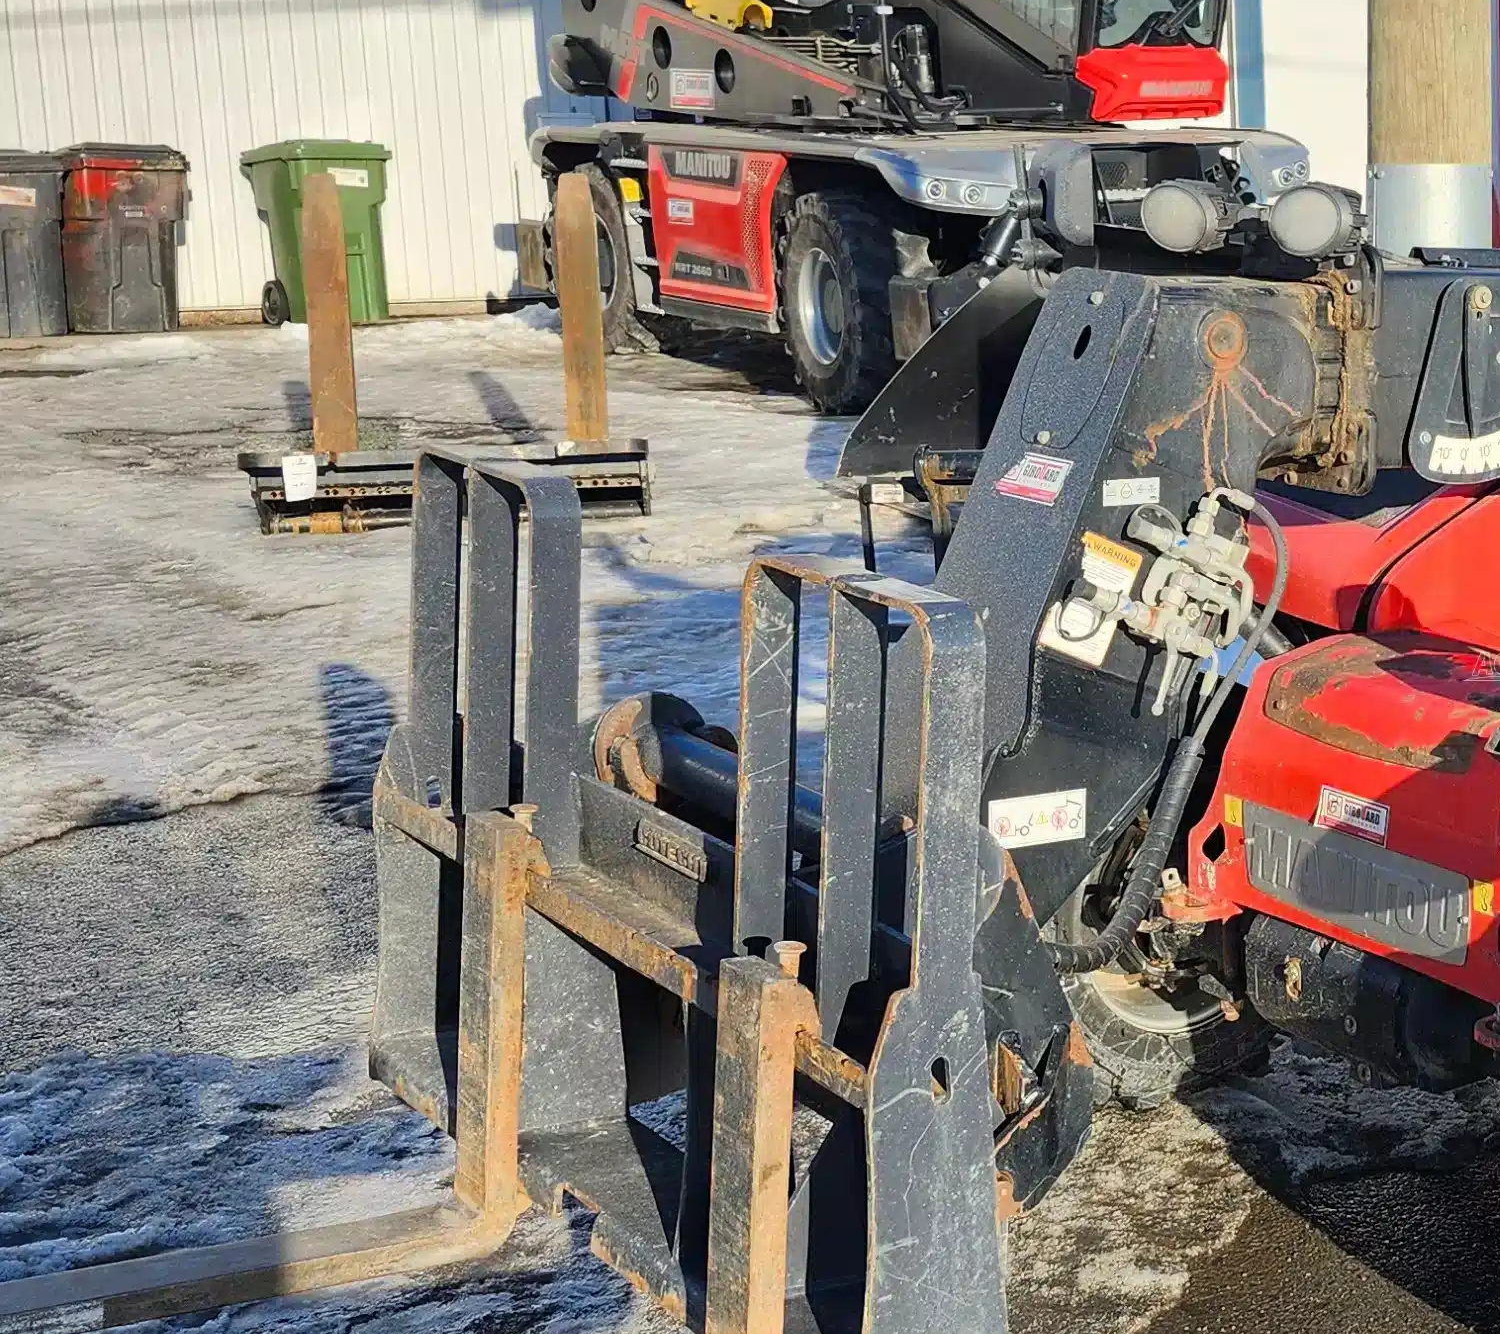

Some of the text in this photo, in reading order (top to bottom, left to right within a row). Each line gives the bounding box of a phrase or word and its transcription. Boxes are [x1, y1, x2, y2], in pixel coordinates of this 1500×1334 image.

[675, 150, 732, 179] MANITOU
[1092, 541, 1137, 568] WARNING
[1249, 821, 1464, 949] MANITOU
